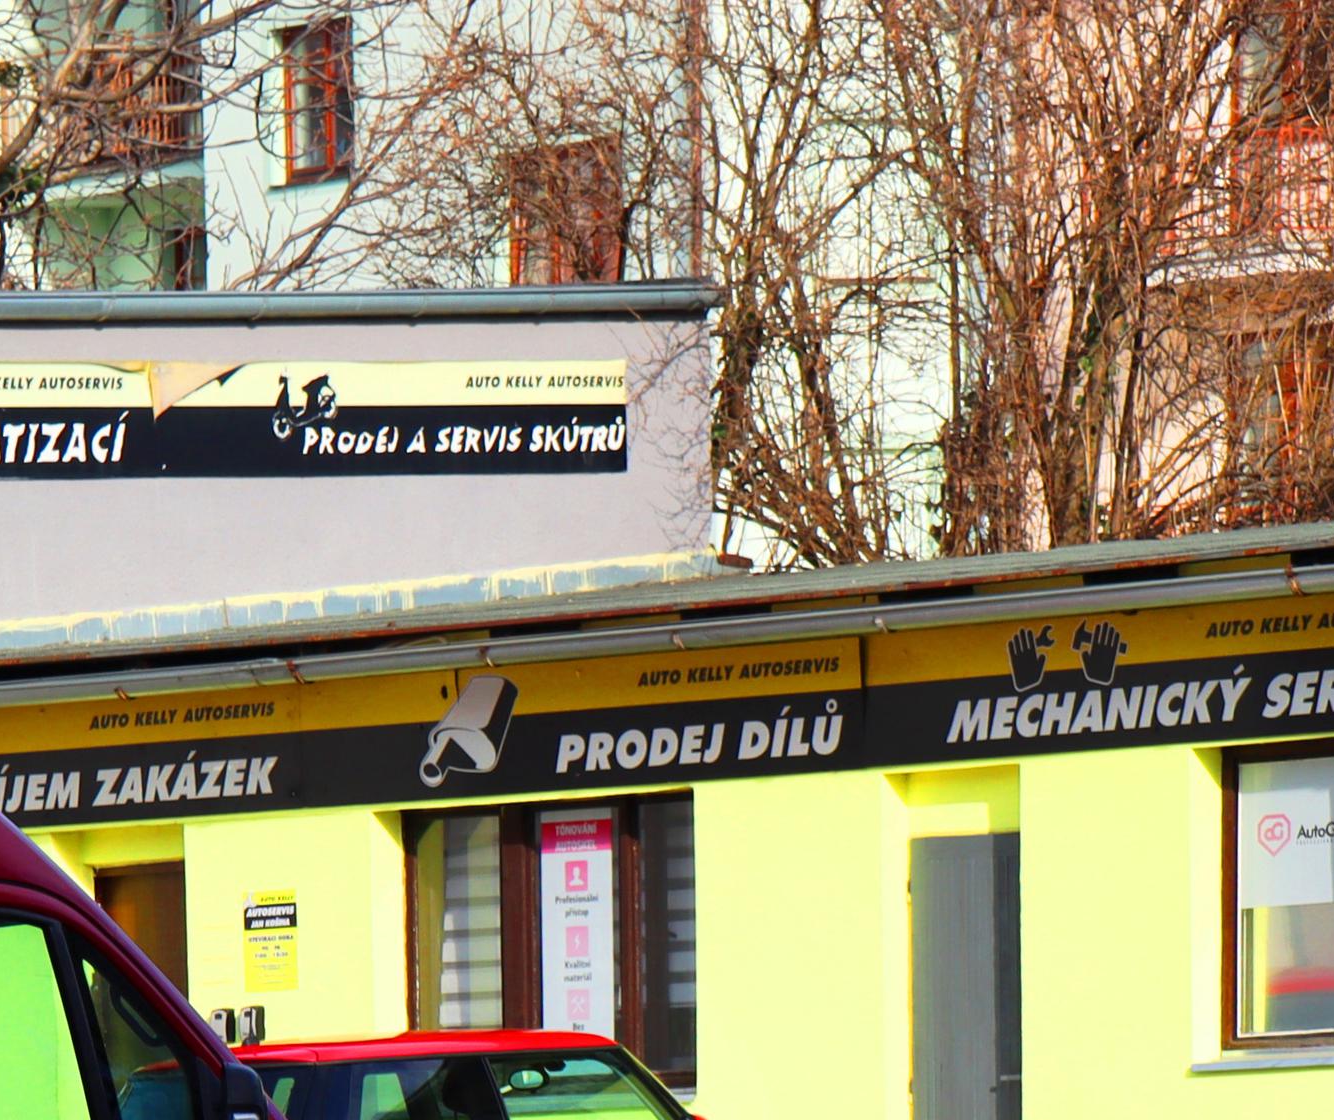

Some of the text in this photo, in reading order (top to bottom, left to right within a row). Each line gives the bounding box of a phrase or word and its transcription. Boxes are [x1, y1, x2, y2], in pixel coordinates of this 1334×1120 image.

[39, 376, 124, 390] AUTOSERVIS
[466, 375, 624, 389] AUTO KELLY AUTOSERVIS
[302, 416, 626, 455] PRODEJ A SERVIS SKÚTRŮ
[1205, 619, 1254, 639] AUTO
[1259, 614, 1312, 635] KELLY
[638, 656, 840, 687] AUTO KELLY AUTOSERVIS
[90, 702, 275, 731] AUTO KELLY AUTOSERVIS
[946, 663, 1253, 744] MECHANICKÝ
[555, 698, 843, 774] PRODEJ DÍLŮ
[91, 750, 279, 807] ZAKÁZEK
[245, 904, 295, 919] AUTOSERVIS
